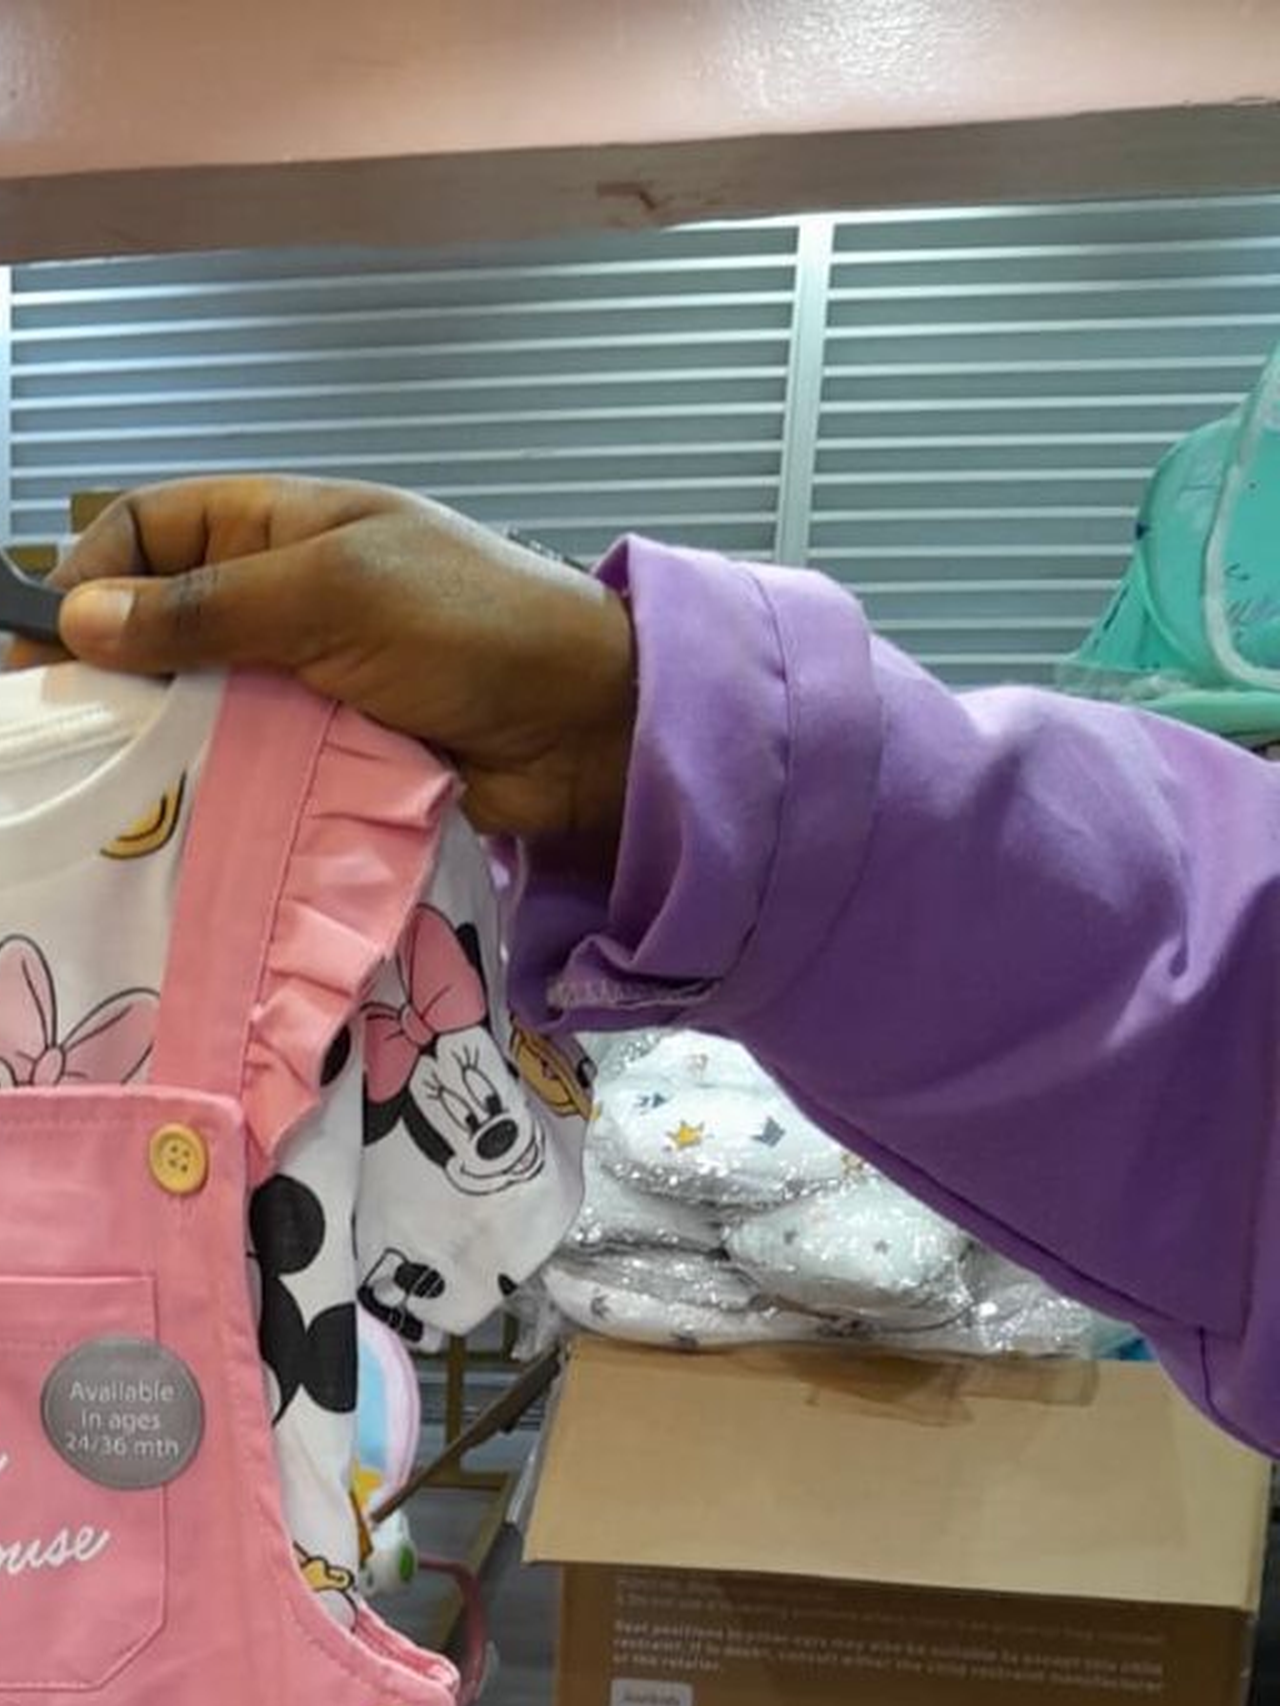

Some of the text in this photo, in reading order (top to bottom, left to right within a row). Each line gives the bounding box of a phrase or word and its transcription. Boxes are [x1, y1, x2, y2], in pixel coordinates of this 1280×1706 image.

[69, 1379, 176, 1403] Available
[108, 1412, 162, 1436] ages
[65, 1431, 180, 1459] 24/36 mth
